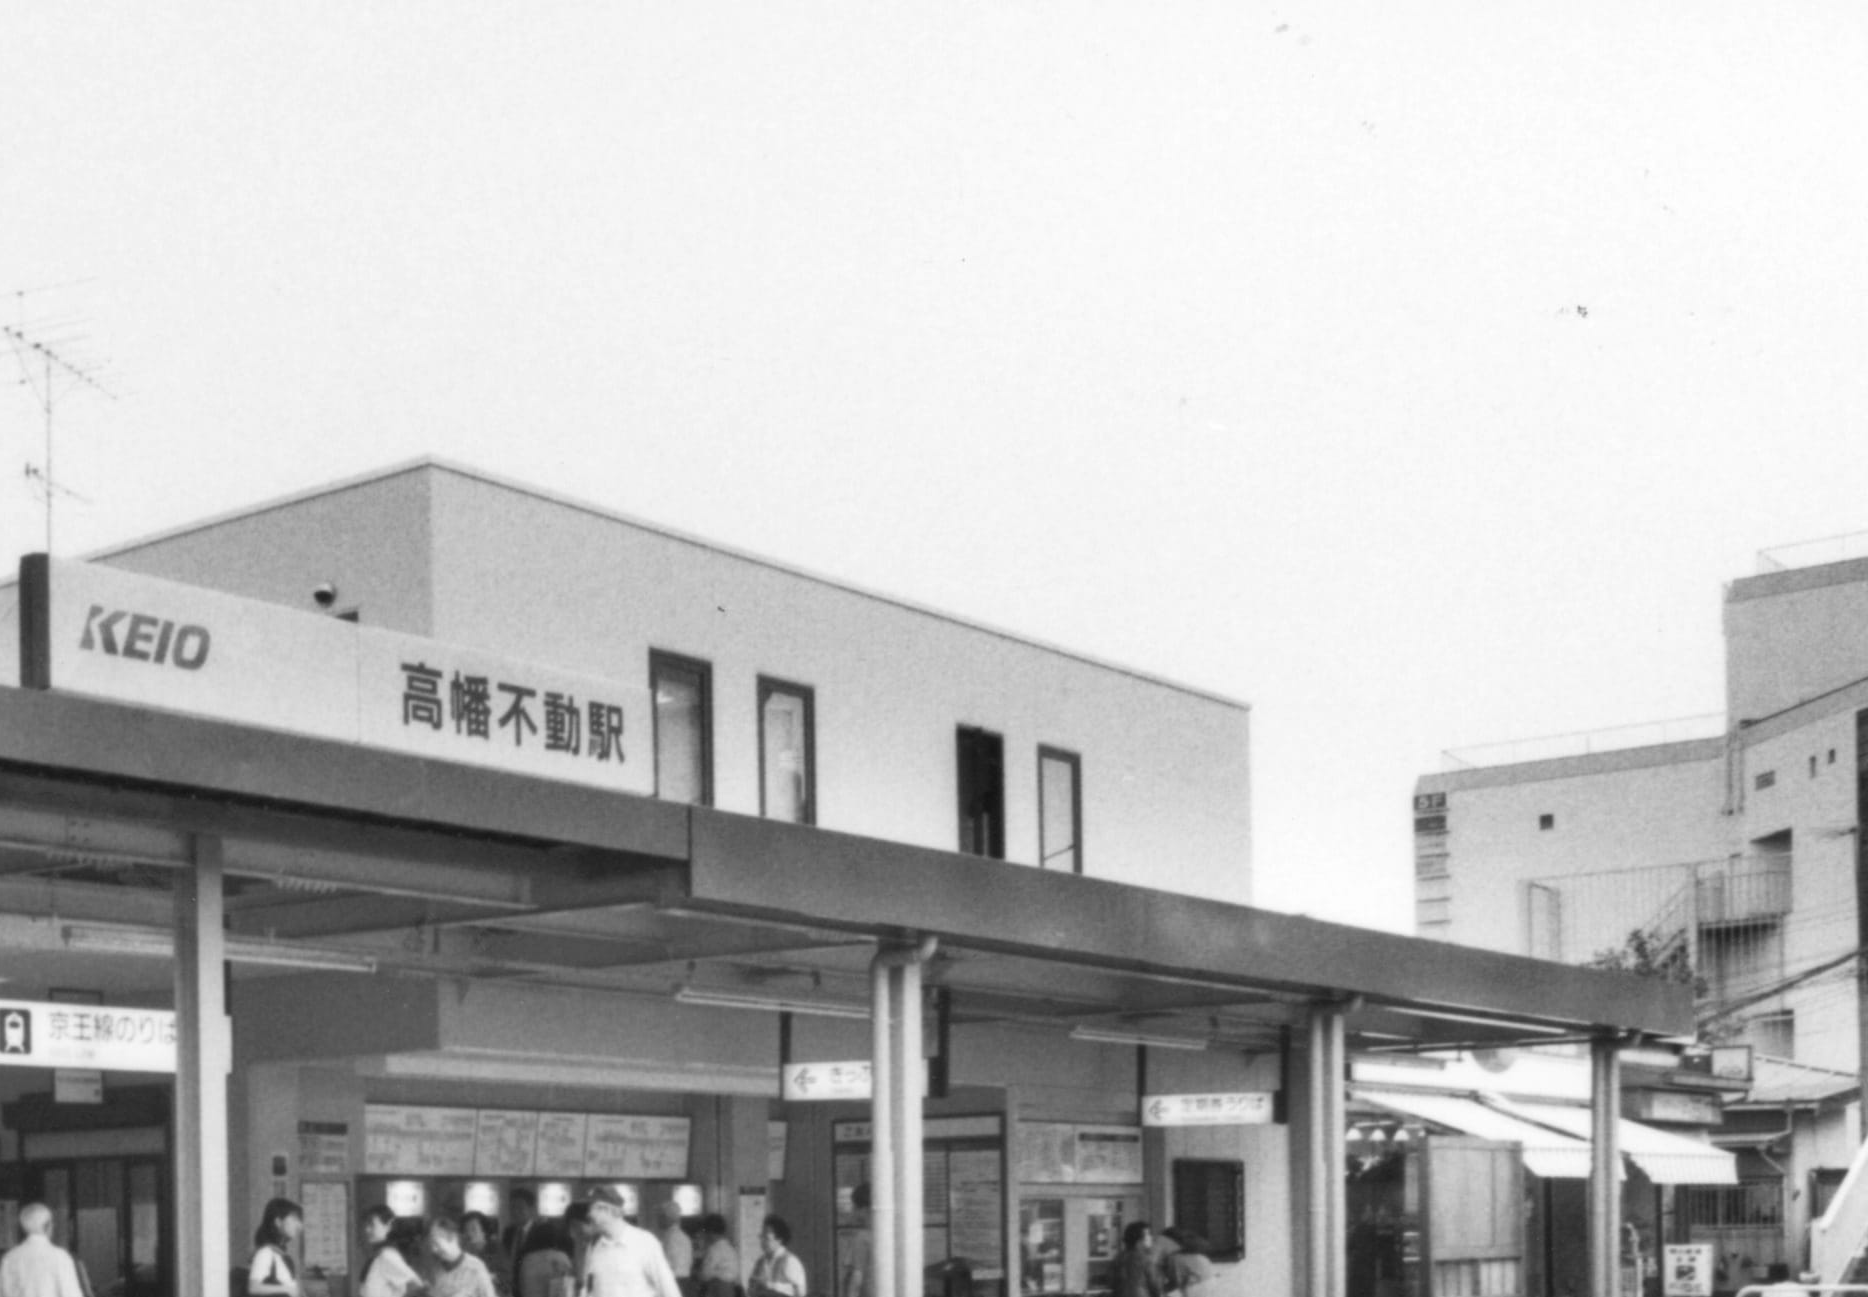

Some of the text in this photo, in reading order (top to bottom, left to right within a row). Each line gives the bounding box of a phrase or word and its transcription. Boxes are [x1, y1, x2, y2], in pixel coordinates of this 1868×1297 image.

[79, 603, 211, 671] KEIO
[399, 660, 627, 765] 高幡不動駅
